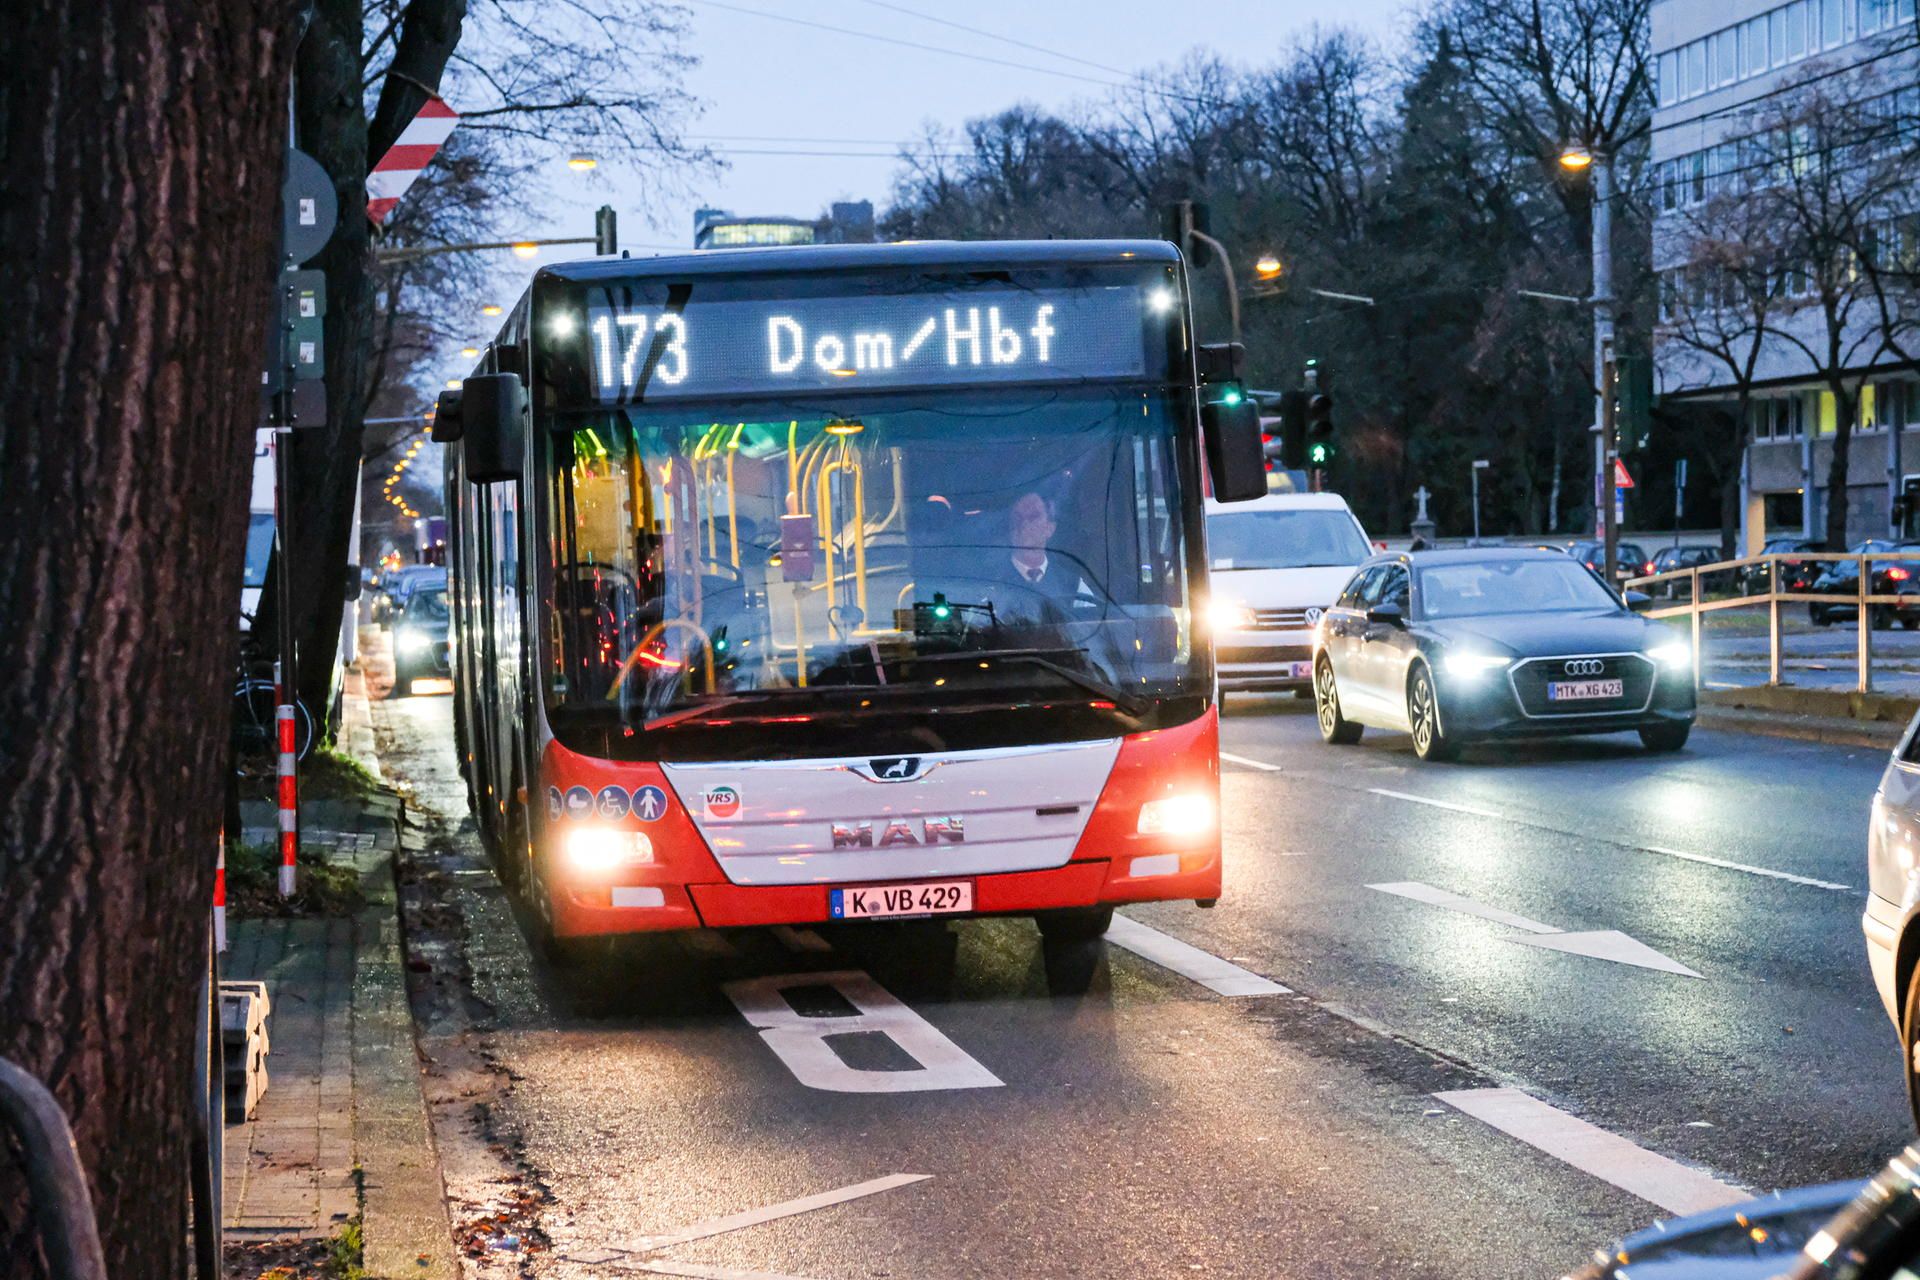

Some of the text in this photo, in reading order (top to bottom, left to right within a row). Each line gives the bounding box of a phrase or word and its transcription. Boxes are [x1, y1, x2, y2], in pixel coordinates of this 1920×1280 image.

[593, 304, 1055, 387] 173 Dom/Hbf
[1556, 681, 1622, 698] MTK XG 423
[706, 793, 732, 803] VRS
[831, 815, 964, 848] MAN
[852, 891, 868, 914] K
[883, 889, 914, 912] VB
[918, 886, 961, 909] 429
